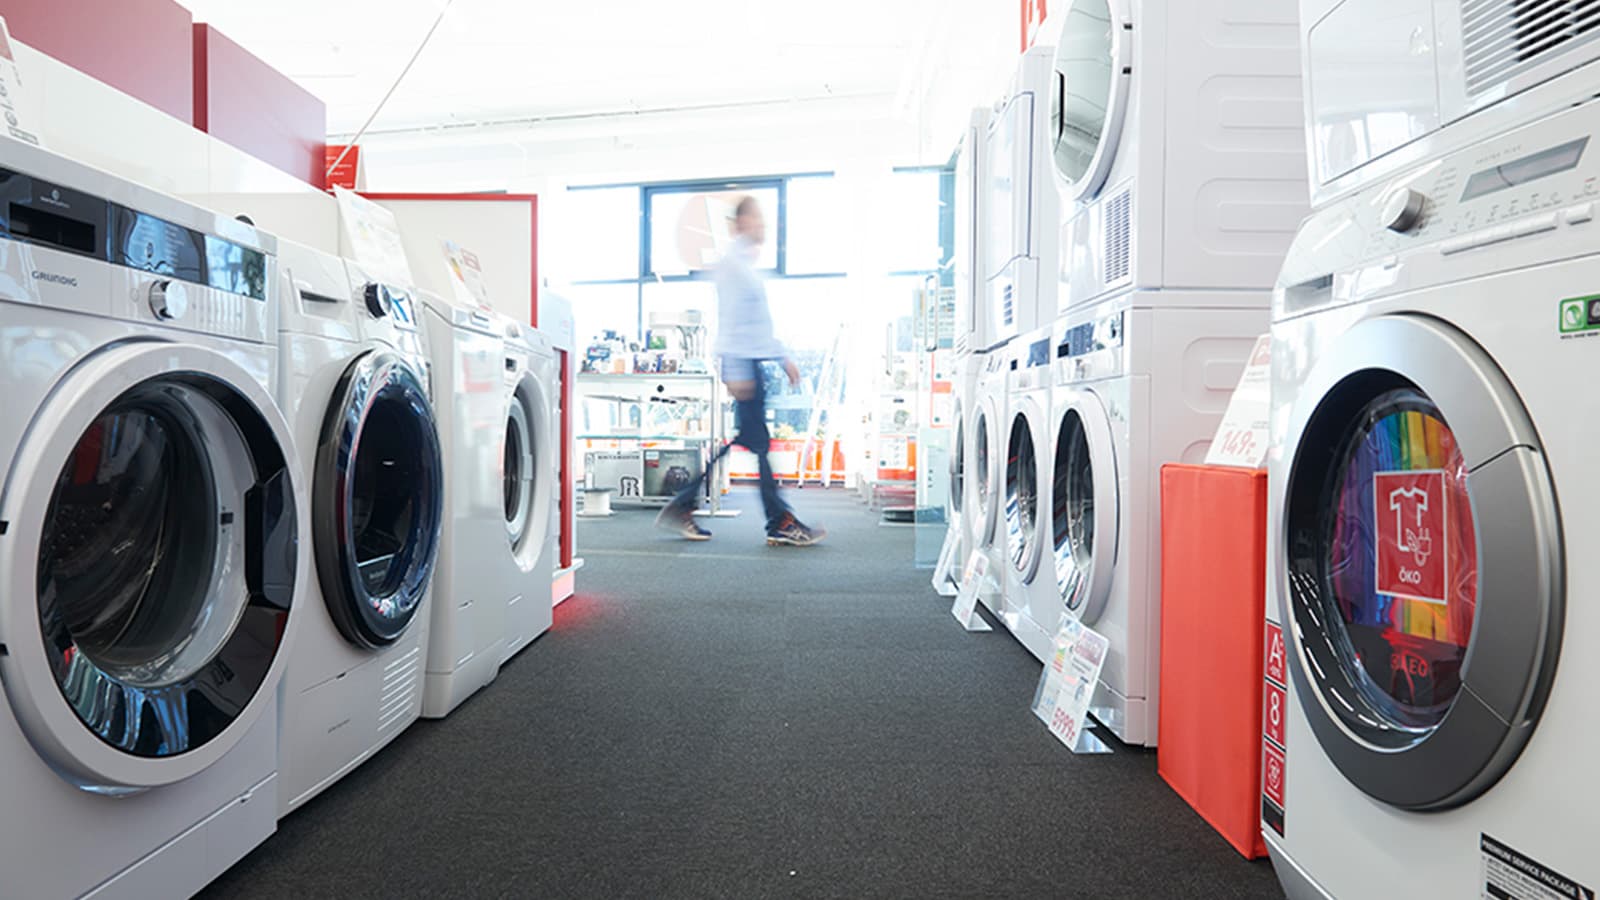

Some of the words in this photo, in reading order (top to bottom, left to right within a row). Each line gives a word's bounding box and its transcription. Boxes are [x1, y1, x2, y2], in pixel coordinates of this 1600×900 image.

[31, 269, 78, 287] GRUNDIG
[1398, 565, 1421, 584] ÖKO
[1270, 690, 1280, 726] 8
[1482, 839, 1511, 861] PREMIUM
[1511, 855, 1539, 877] SERVICE
[1540, 871, 1576, 896] PACKAGE
